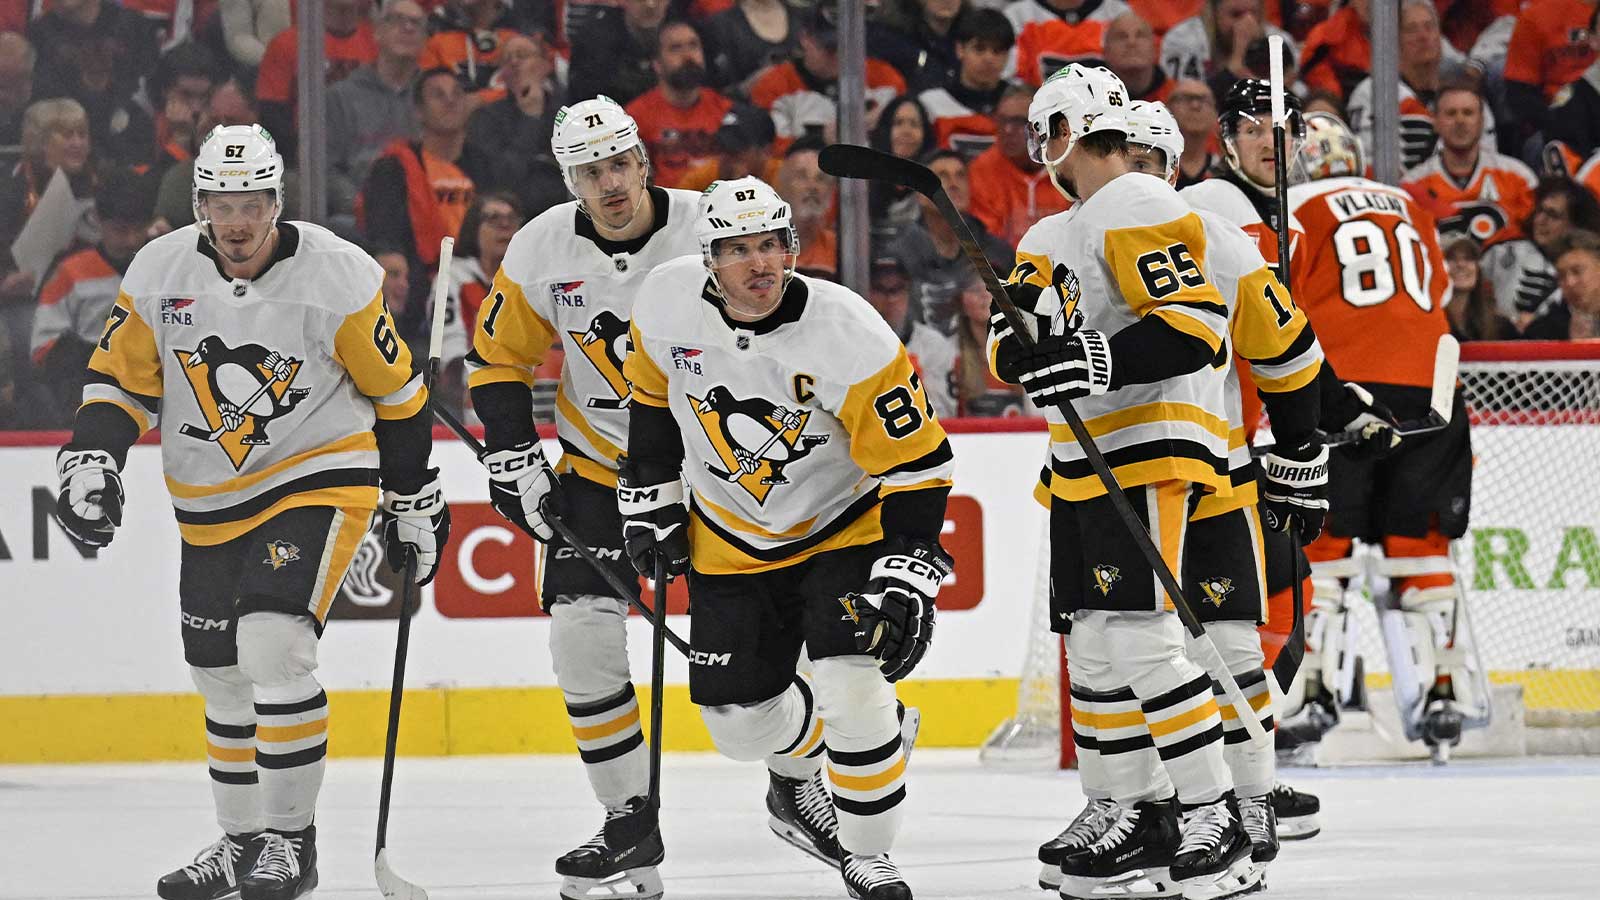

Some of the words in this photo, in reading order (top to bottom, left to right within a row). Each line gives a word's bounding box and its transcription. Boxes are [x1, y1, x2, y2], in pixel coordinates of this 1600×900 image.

[1108, 91, 1123, 107] 65
[585, 113, 604, 129] 71
[225, 145, 245, 158] 67
[735, 189, 756, 202] 87
[737, 211, 766, 220] CCM
[1136, 242, 1206, 300] 65
[1333, 219, 1433, 313] 80
[162, 312, 194, 327] F.N.B.
[793, 373, 816, 404] C
[60, 453, 108, 474] CM
[489, 448, 546, 474] CCM
[913, 548, 928, 559] 87
[883, 557, 942, 585] CCM
[182, 611, 229, 631] CCM
